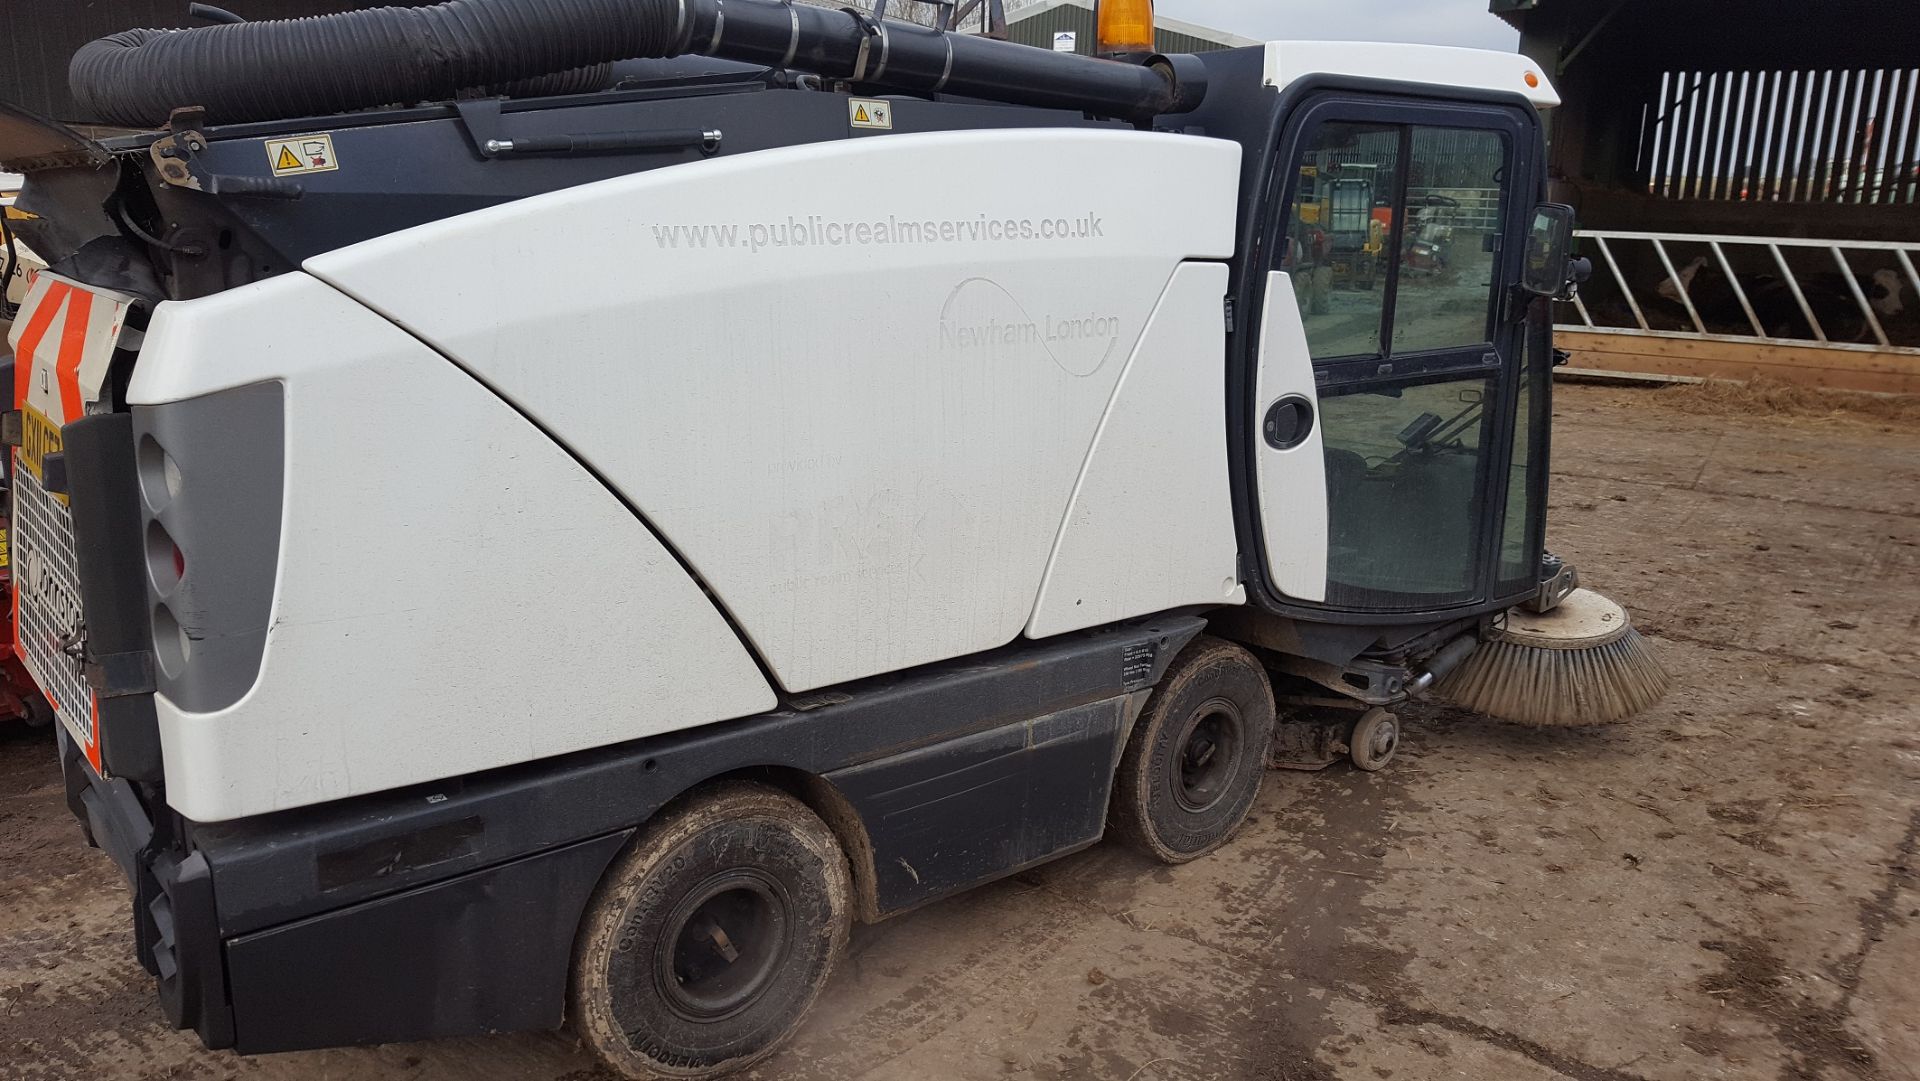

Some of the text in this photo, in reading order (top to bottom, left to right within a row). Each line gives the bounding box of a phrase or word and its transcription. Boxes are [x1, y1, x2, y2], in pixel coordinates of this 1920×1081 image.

[652, 212, 1104, 253] www.publicrealmservices.co.uk
[939, 313, 1120, 350] Newham London
